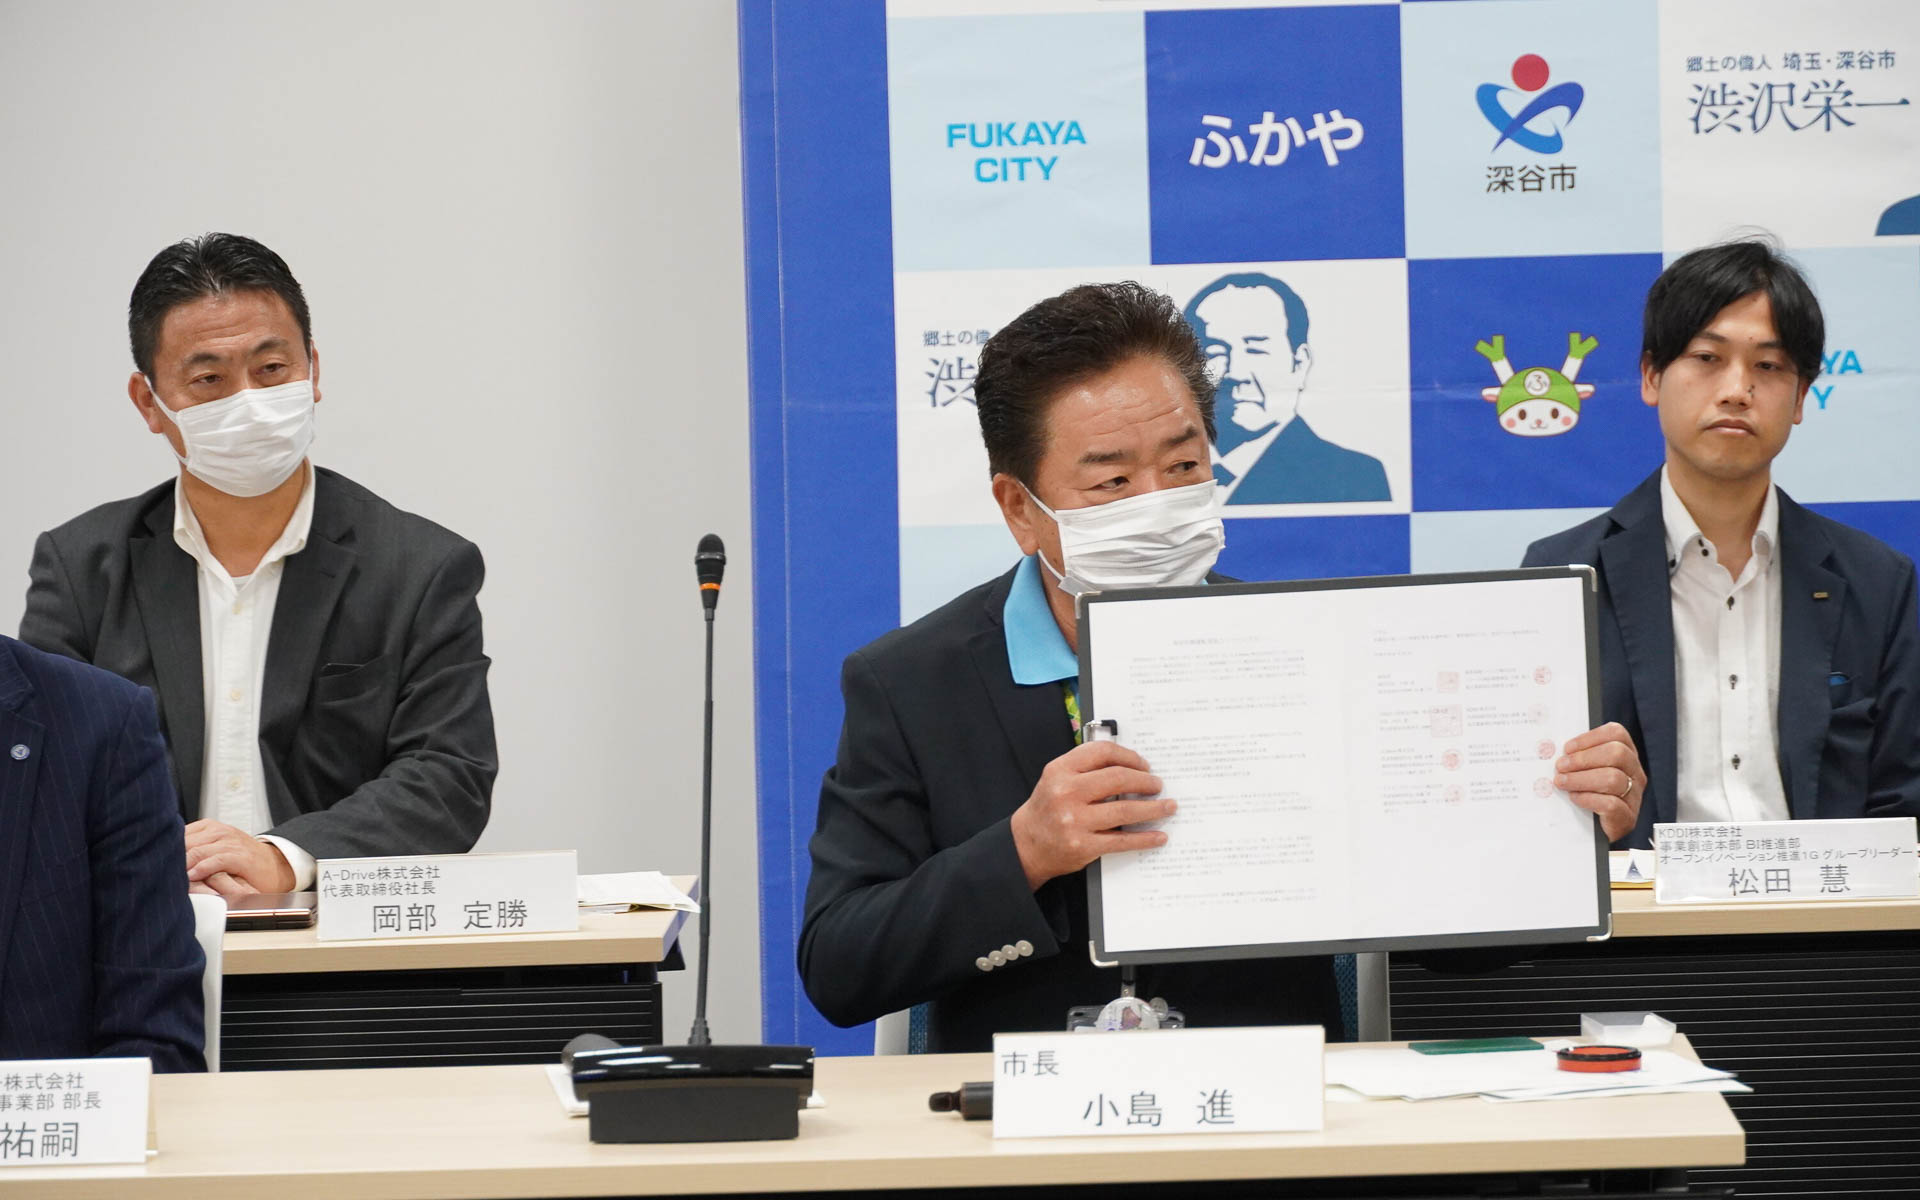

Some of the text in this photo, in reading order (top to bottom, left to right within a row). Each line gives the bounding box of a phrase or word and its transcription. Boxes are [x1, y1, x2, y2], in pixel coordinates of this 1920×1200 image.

[1686, 50, 1896, 73] 郷土の偉人 埼玉・深谷市
[1688, 79, 1910, 134] 渋沢栄一
[947, 120, 1086, 148] FUKAYA
[1188, 109, 1364, 168] ふかや
[974, 156, 1058, 182] CITY
[1485, 165, 1577, 193] 深谷市
[1658, 826, 1743, 839] KDDI株式会社
[1660, 837, 1801, 853] 事業創造本部 BI推進部
[322, 865, 440, 881] A-Drive株式会社
[1728, 863, 1851, 897] 松田 慧
[322, 881, 437, 898] 代表取締役社長
[373, 899, 528, 933] 岡部 定勝
[1001, 1050, 1060, 1077] 市長
[0, 1072, 85, 1091] 株式会社
[63, 1091, 102, 1110] 部長
[1083, 1088, 1236, 1127] 小島 進
[0, 1121, 79, 1159] 祐嗣
